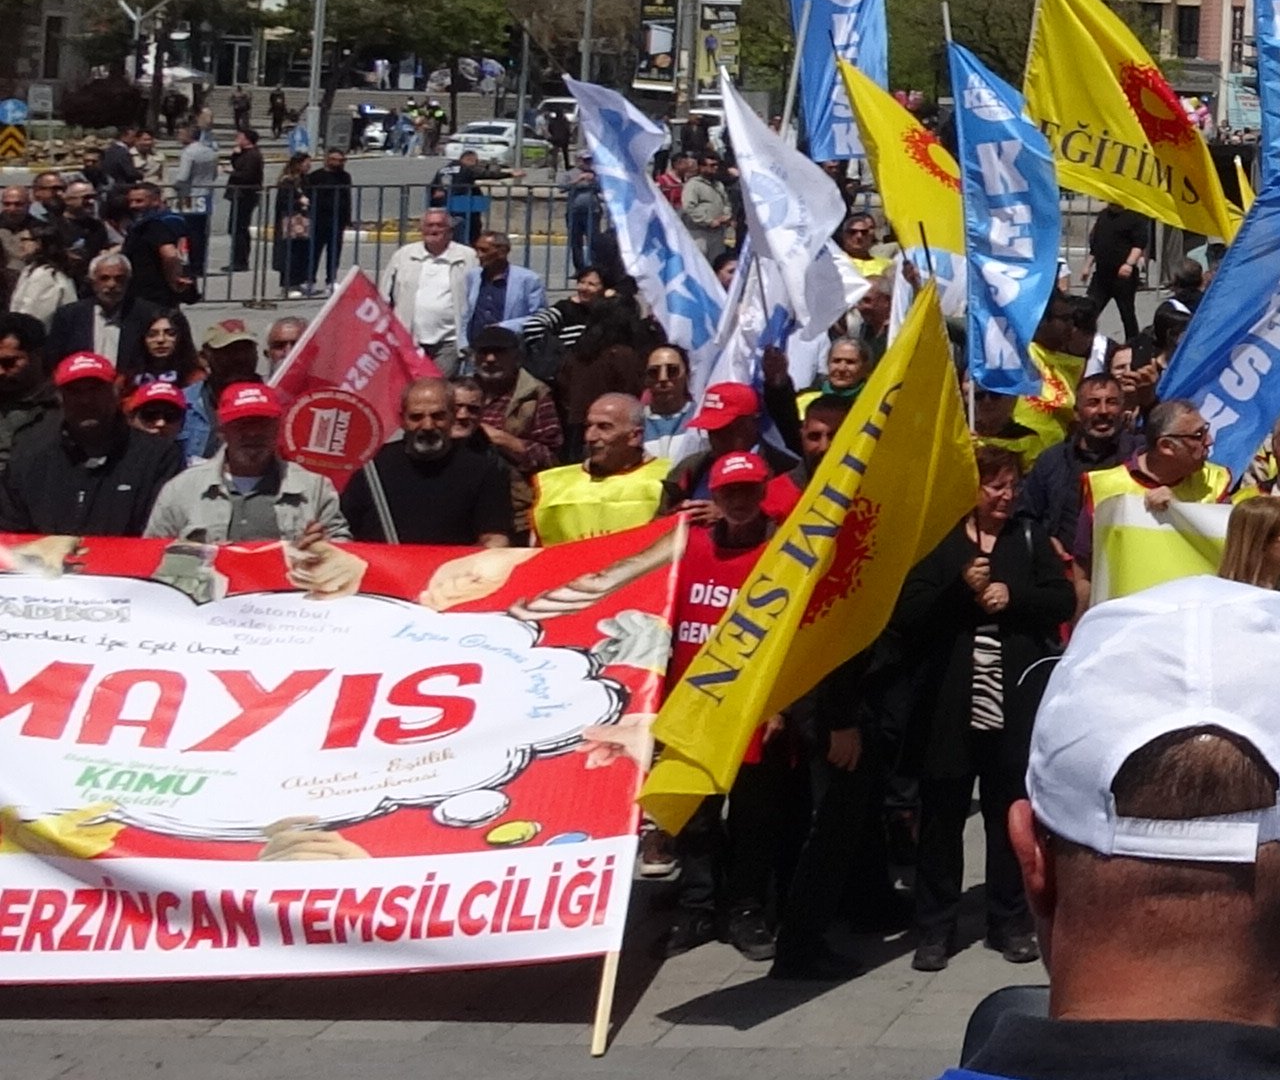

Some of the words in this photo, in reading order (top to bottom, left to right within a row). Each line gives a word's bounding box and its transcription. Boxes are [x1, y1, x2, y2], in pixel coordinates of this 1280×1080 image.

[686, 574, 790, 708] SEN
[0, 661, 483, 753] MAYIS
[75, 764, 210, 797] KAMU
[0, 876, 258, 952] ERZİNCAN
[270, 855, 616, 947] TEMSİLCİLİĞİ
